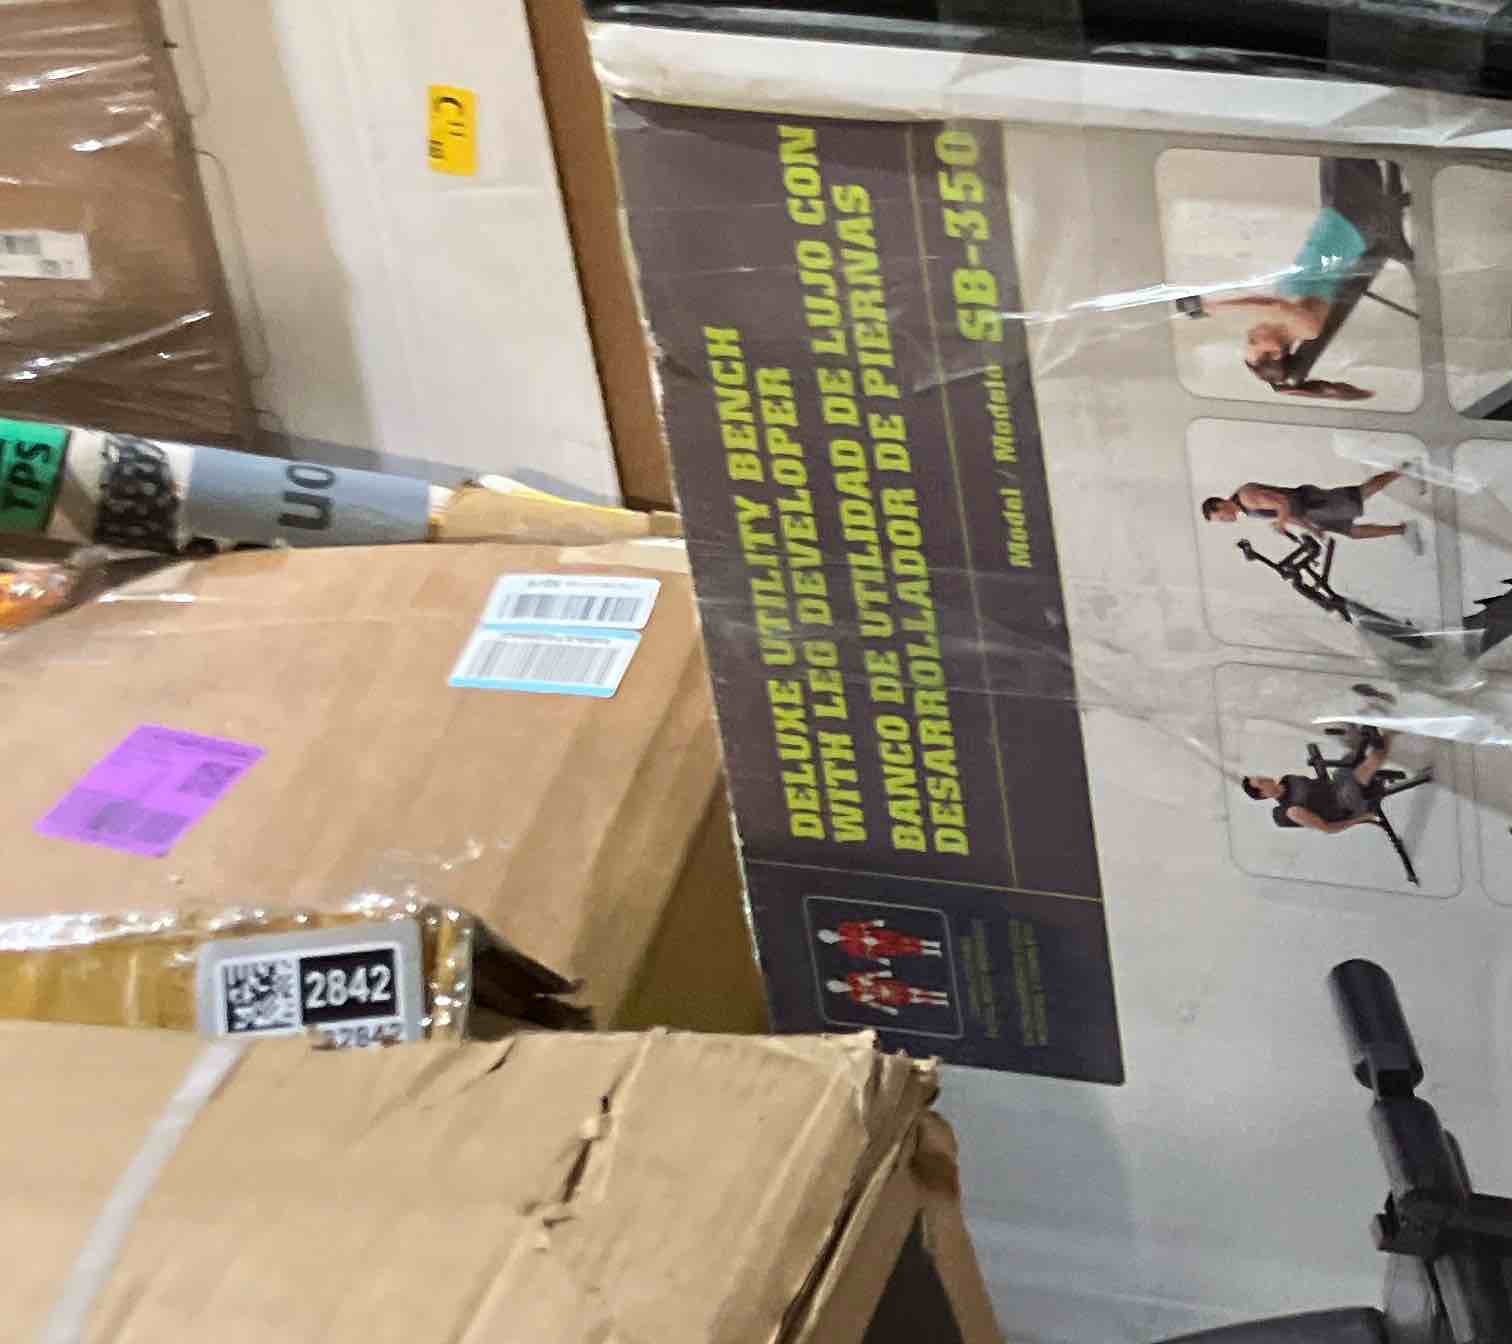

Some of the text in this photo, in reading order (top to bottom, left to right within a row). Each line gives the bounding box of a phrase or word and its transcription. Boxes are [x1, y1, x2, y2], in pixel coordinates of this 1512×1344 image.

[934, 127, 1004, 344] SB-350
[3, 441, 52, 514] TPS
[703, 326, 827, 841] DELUXE UTILITY BENCH
[754, 366, 867, 844] WITH LEG DEVELOPER
[777, 124, 928, 854] BANCO DE UTILIDAD DE LUJO CON
[832, 183, 970, 857] DESARROLLADOR DE PIERNAS
[999, 487, 1032, 569] Model
[304, 965, 393, 1011] 2842
